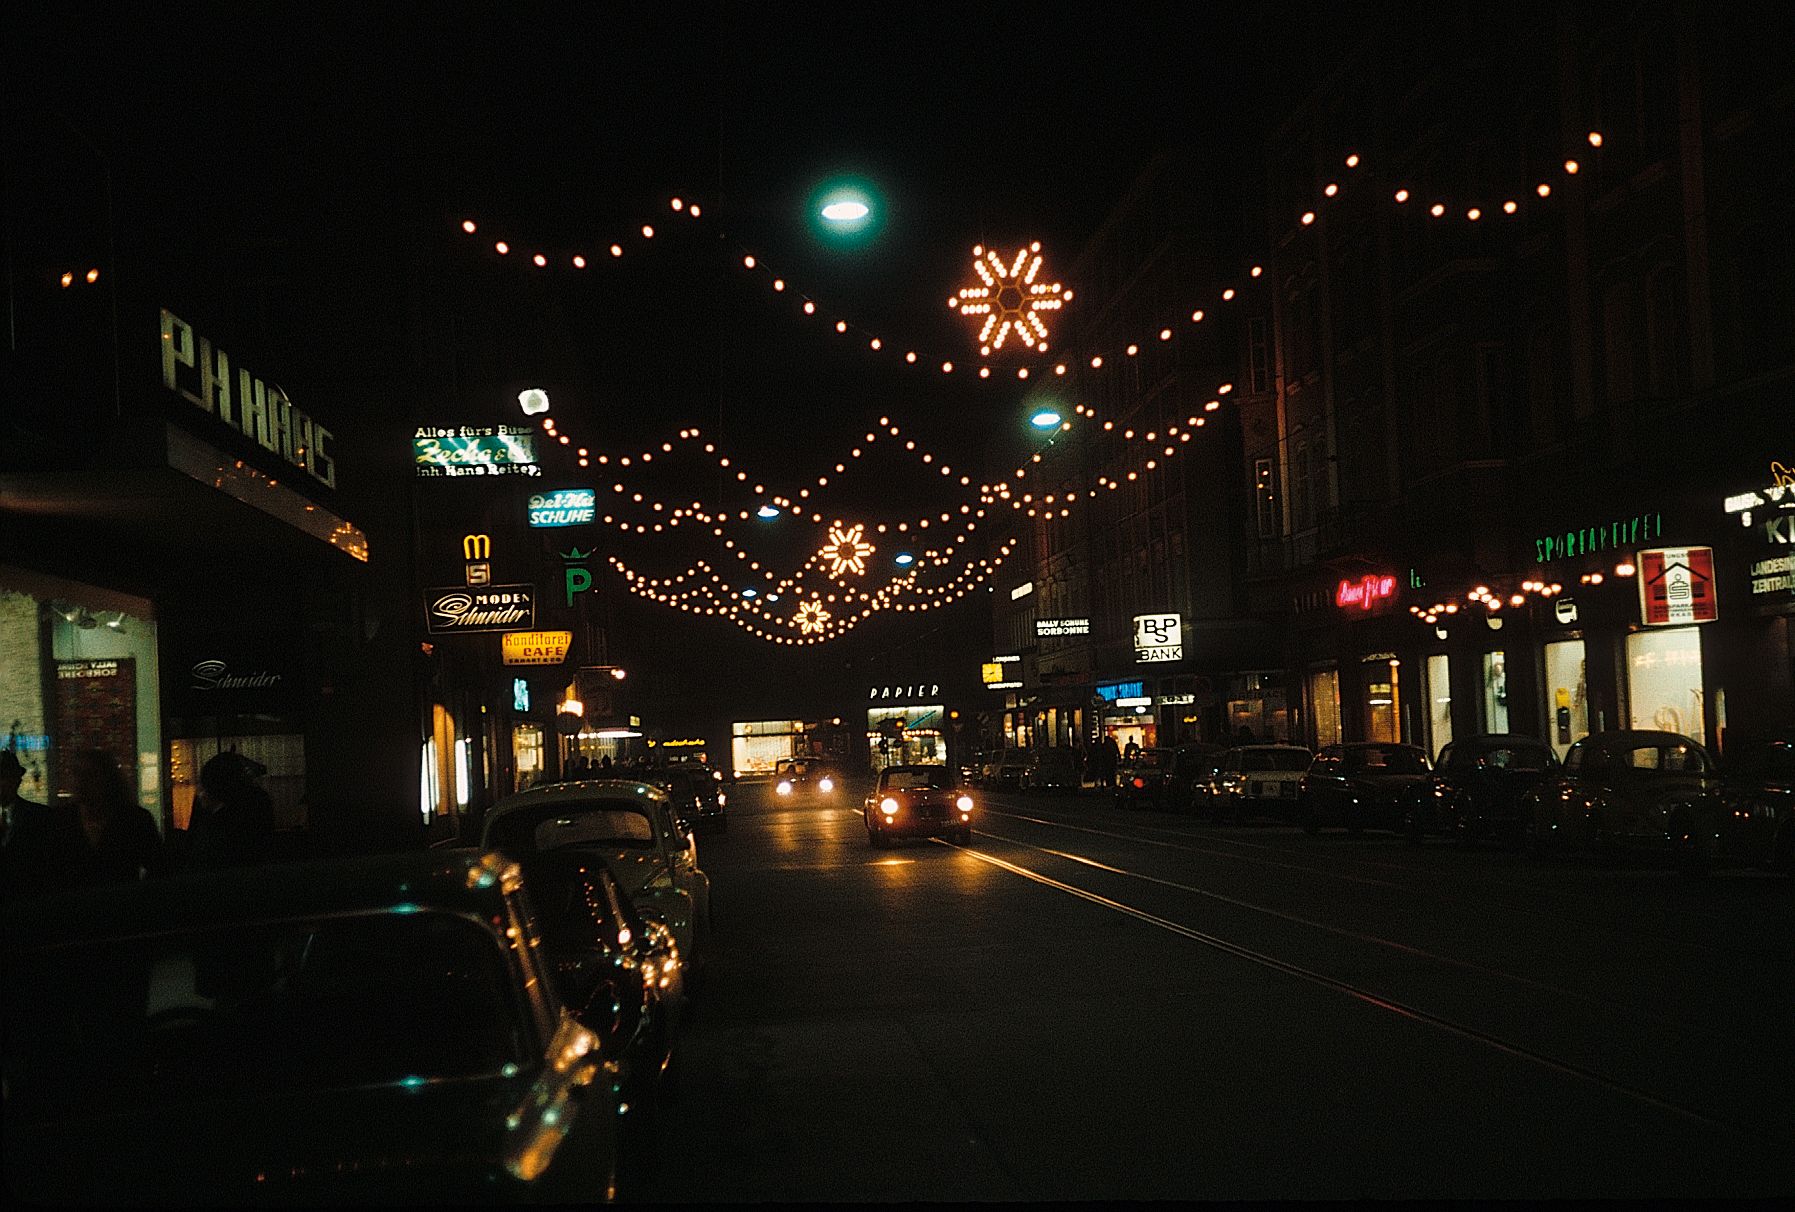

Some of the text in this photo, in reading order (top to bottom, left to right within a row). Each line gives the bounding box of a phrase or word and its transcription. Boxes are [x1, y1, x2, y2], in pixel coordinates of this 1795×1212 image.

[415, 427, 454, 437] Alles
[445, 465, 484, 476] Hans
[530, 510, 594, 524] SCHUHE
[566, 568, 592, 607] P
[476, 593, 530, 605] MODEN
[432, 593, 531, 627] Schneider
[1036, 620, 1059, 628] BALLY
[1037, 627, 1089, 636] SORBONNE
[505, 632, 568, 646] Konditorei
[1141, 648, 1182, 661] BANK
[192, 660, 281, 690] Schneider
[870, 684, 939, 699] PAPIER
